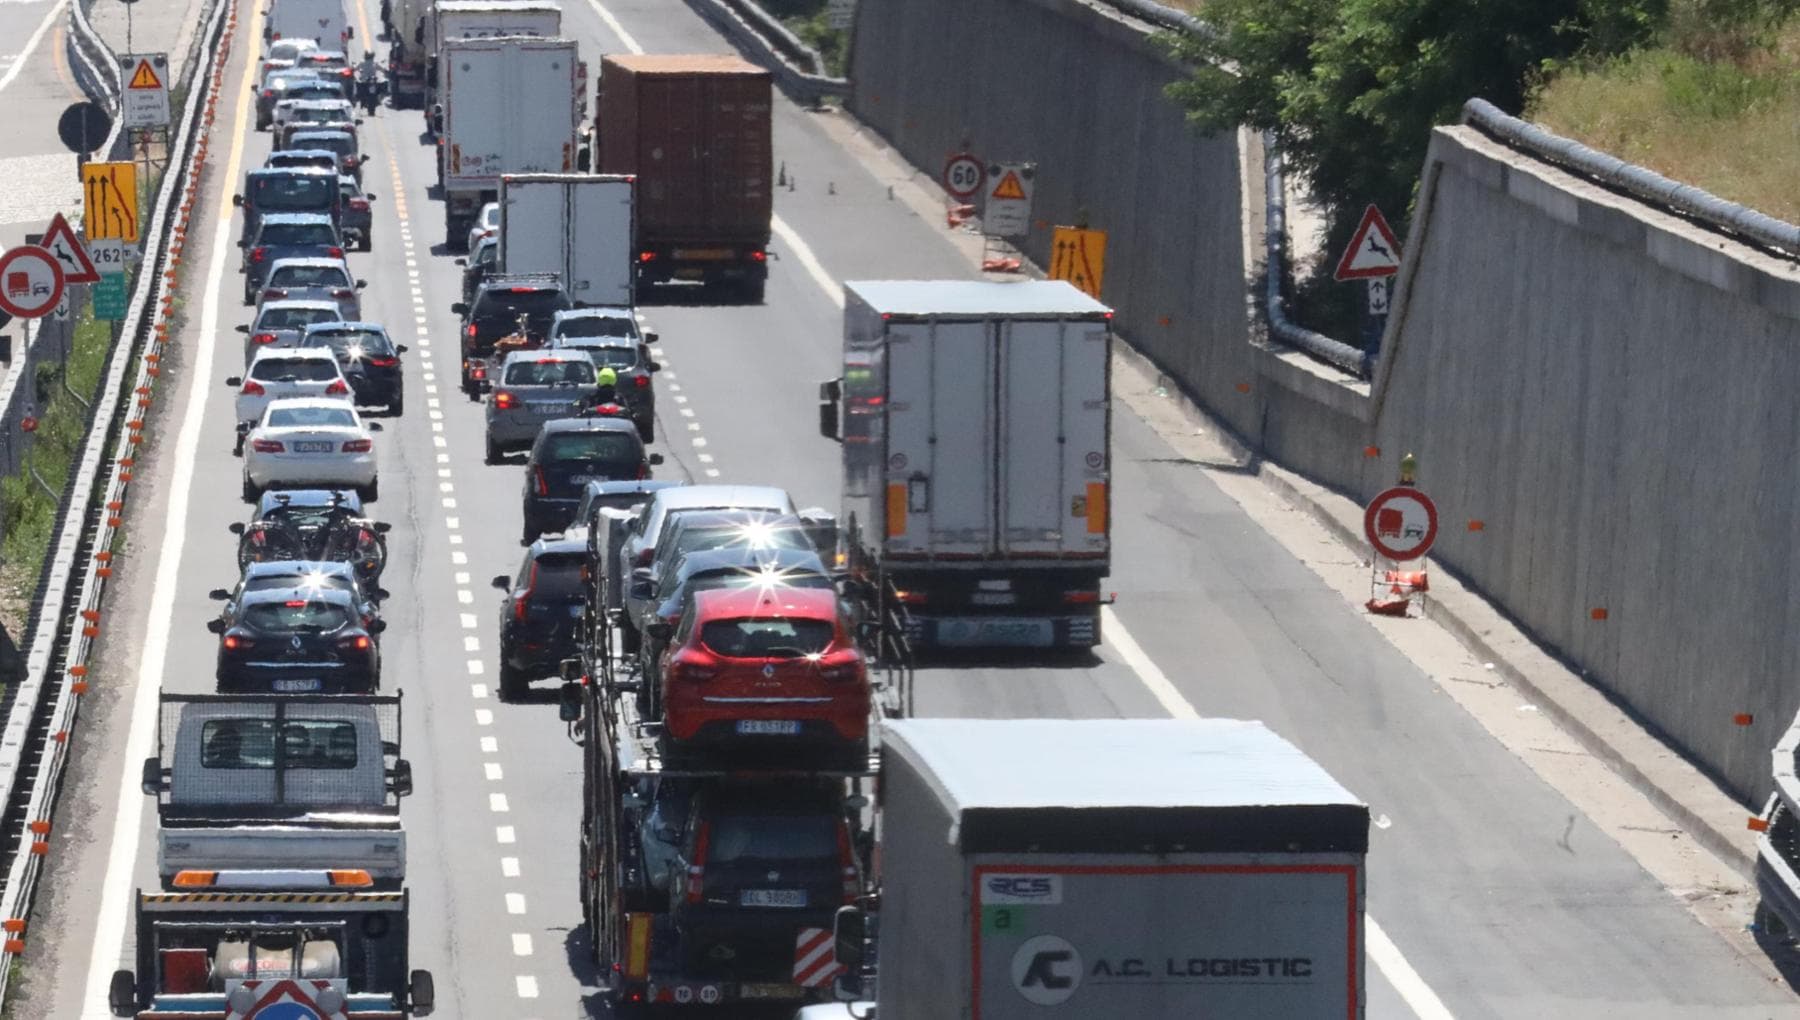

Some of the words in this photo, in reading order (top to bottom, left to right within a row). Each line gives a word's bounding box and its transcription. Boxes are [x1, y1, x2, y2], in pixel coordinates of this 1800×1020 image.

[952, 165, 976, 185] 60
[93, 248, 121, 263] 262
[988, 877, 1051, 895] RCS
[994, 908, 1011, 929] a
[1092, 957, 1150, 977] A.C.
[1167, 956, 1312, 978] LOGISTIC
